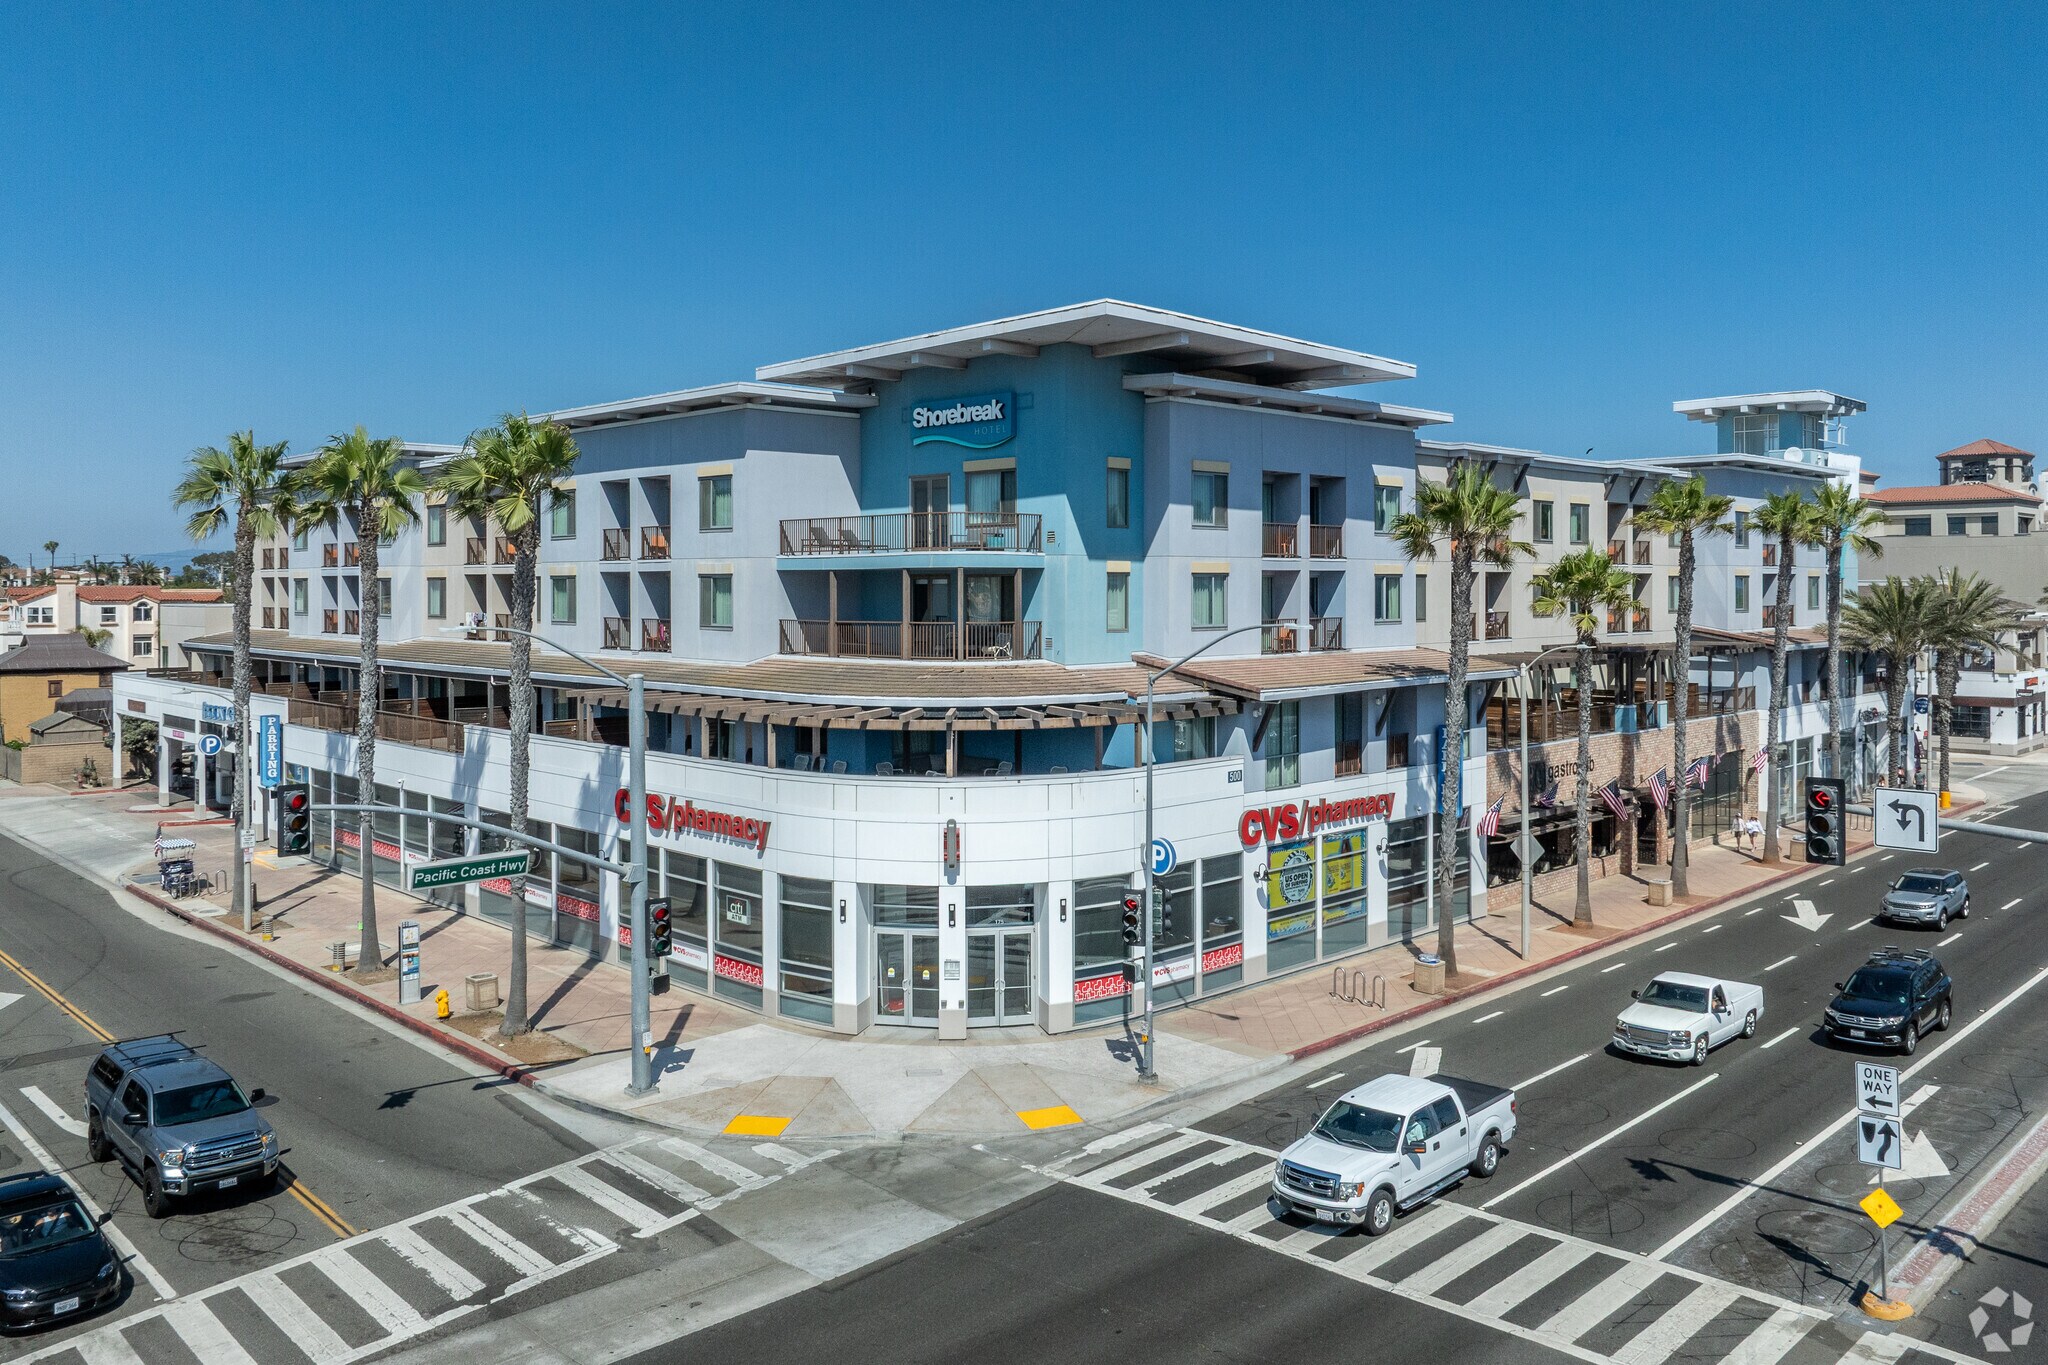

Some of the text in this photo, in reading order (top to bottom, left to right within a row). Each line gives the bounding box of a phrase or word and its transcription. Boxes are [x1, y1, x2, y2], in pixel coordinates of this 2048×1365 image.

[912, 399, 1003, 429] Shorebreak
[974, 424, 1006, 435] HOTEL
[206, 738, 217, 752] P
[267, 716, 278, 778] PARKING
[1229, 771, 1241, 782] 500
[1547, 756, 1595, 783] gastrob
[614, 787, 772, 851] CS/pharmacy
[1238, 792, 1396, 847] CVS/pharmacy
[1152, 844, 1166, 870] P
[414, 860, 526, 884] Pacific Coast Hwy
[1285, 872, 1308, 883] US OPEN
[731, 913, 743, 922] ATM
[1863, 1067, 1892, 1082] ONE
[1862, 1079, 1893, 1095] WAY
